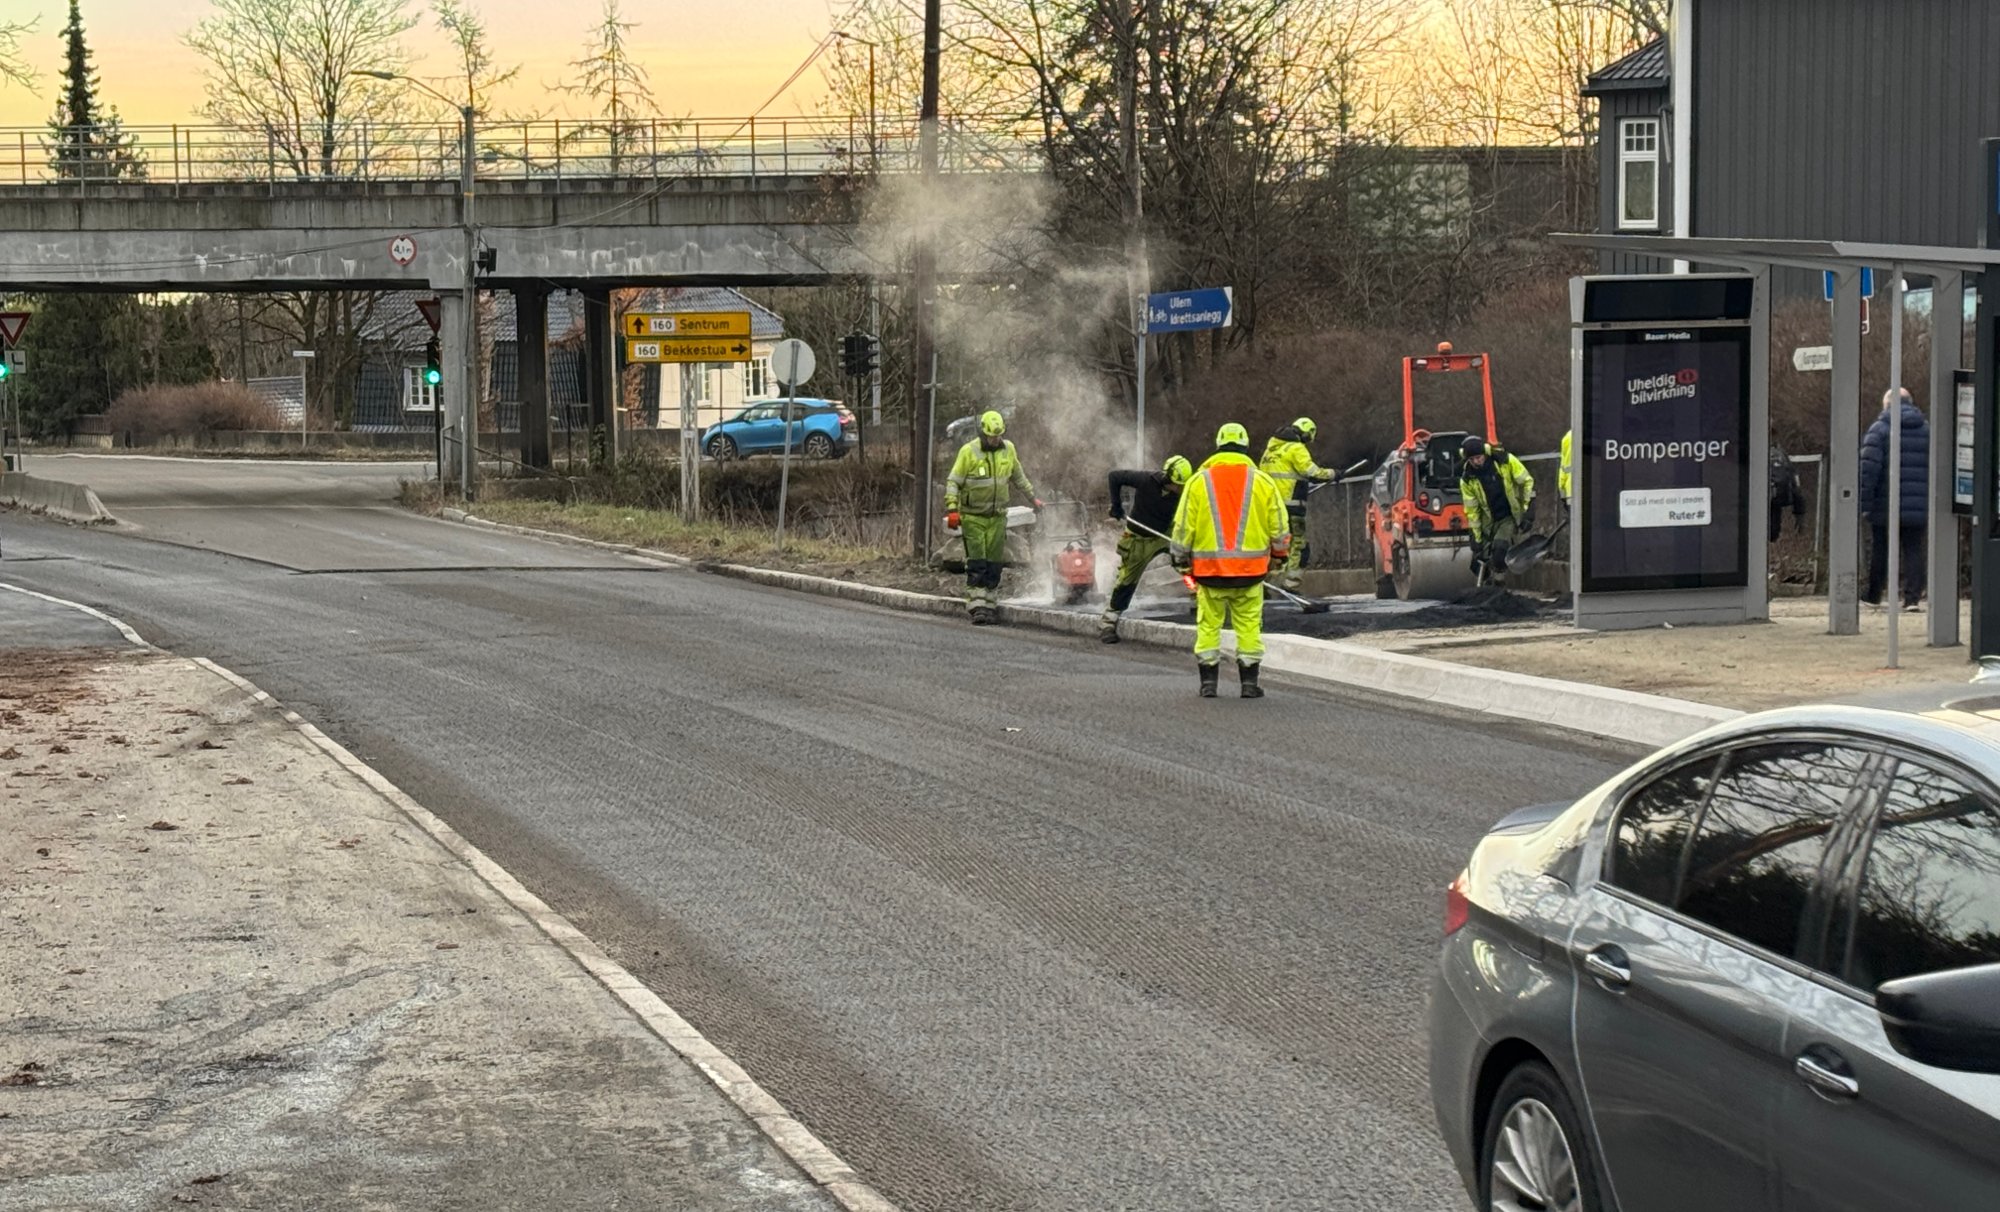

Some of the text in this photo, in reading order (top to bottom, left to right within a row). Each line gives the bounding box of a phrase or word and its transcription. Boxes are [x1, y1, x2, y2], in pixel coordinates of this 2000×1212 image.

[1169, 296, 1192, 309] Ullern
[1170, 309, 1222, 325] Idrettsanlegg
[653, 319, 730, 330] 160 Sentrum
[1645, 331, 1691, 341] Bauer Media
[638, 344, 726, 356] 160 Bekkestua
[1627, 373, 1676, 393] Uheldig
[1630, 384, 1696, 405] bilvirkning
[1605, 439, 1729, 463] Bompenger
